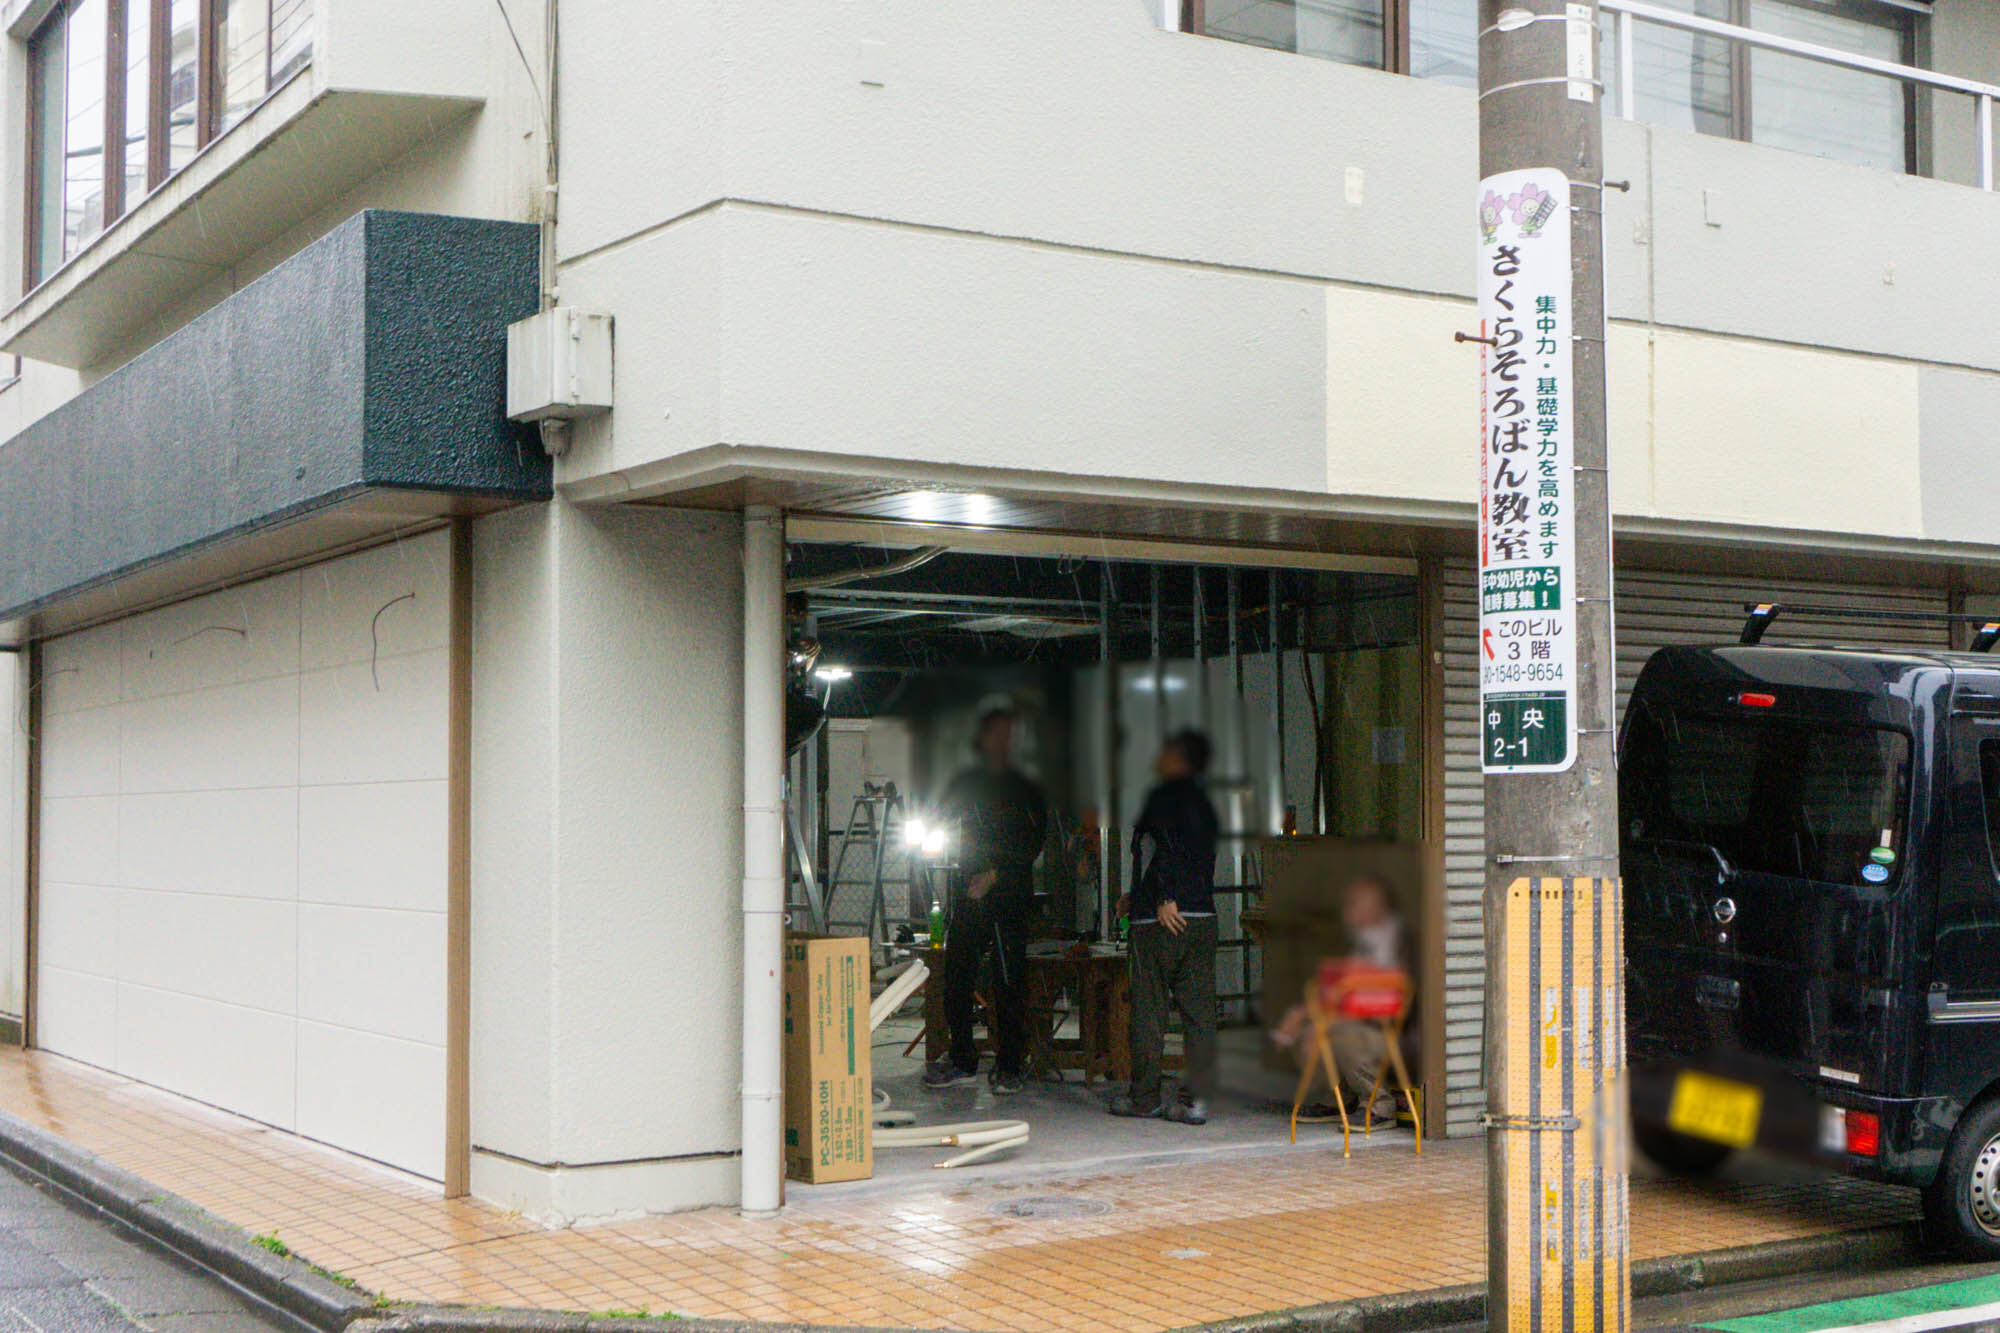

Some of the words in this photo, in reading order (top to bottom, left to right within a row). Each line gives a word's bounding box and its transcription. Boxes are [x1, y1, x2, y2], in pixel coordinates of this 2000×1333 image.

[1491, 245, 1531, 562] さくらそろばん教室
[1535, 296, 1560, 559] 集中力・基礎学力を高めます
[1498, 618, 1563, 638] このビル
[1494, 737, 1528, 757] 2-1
[819, 1081, 830, 1167] PC-3520-10H
